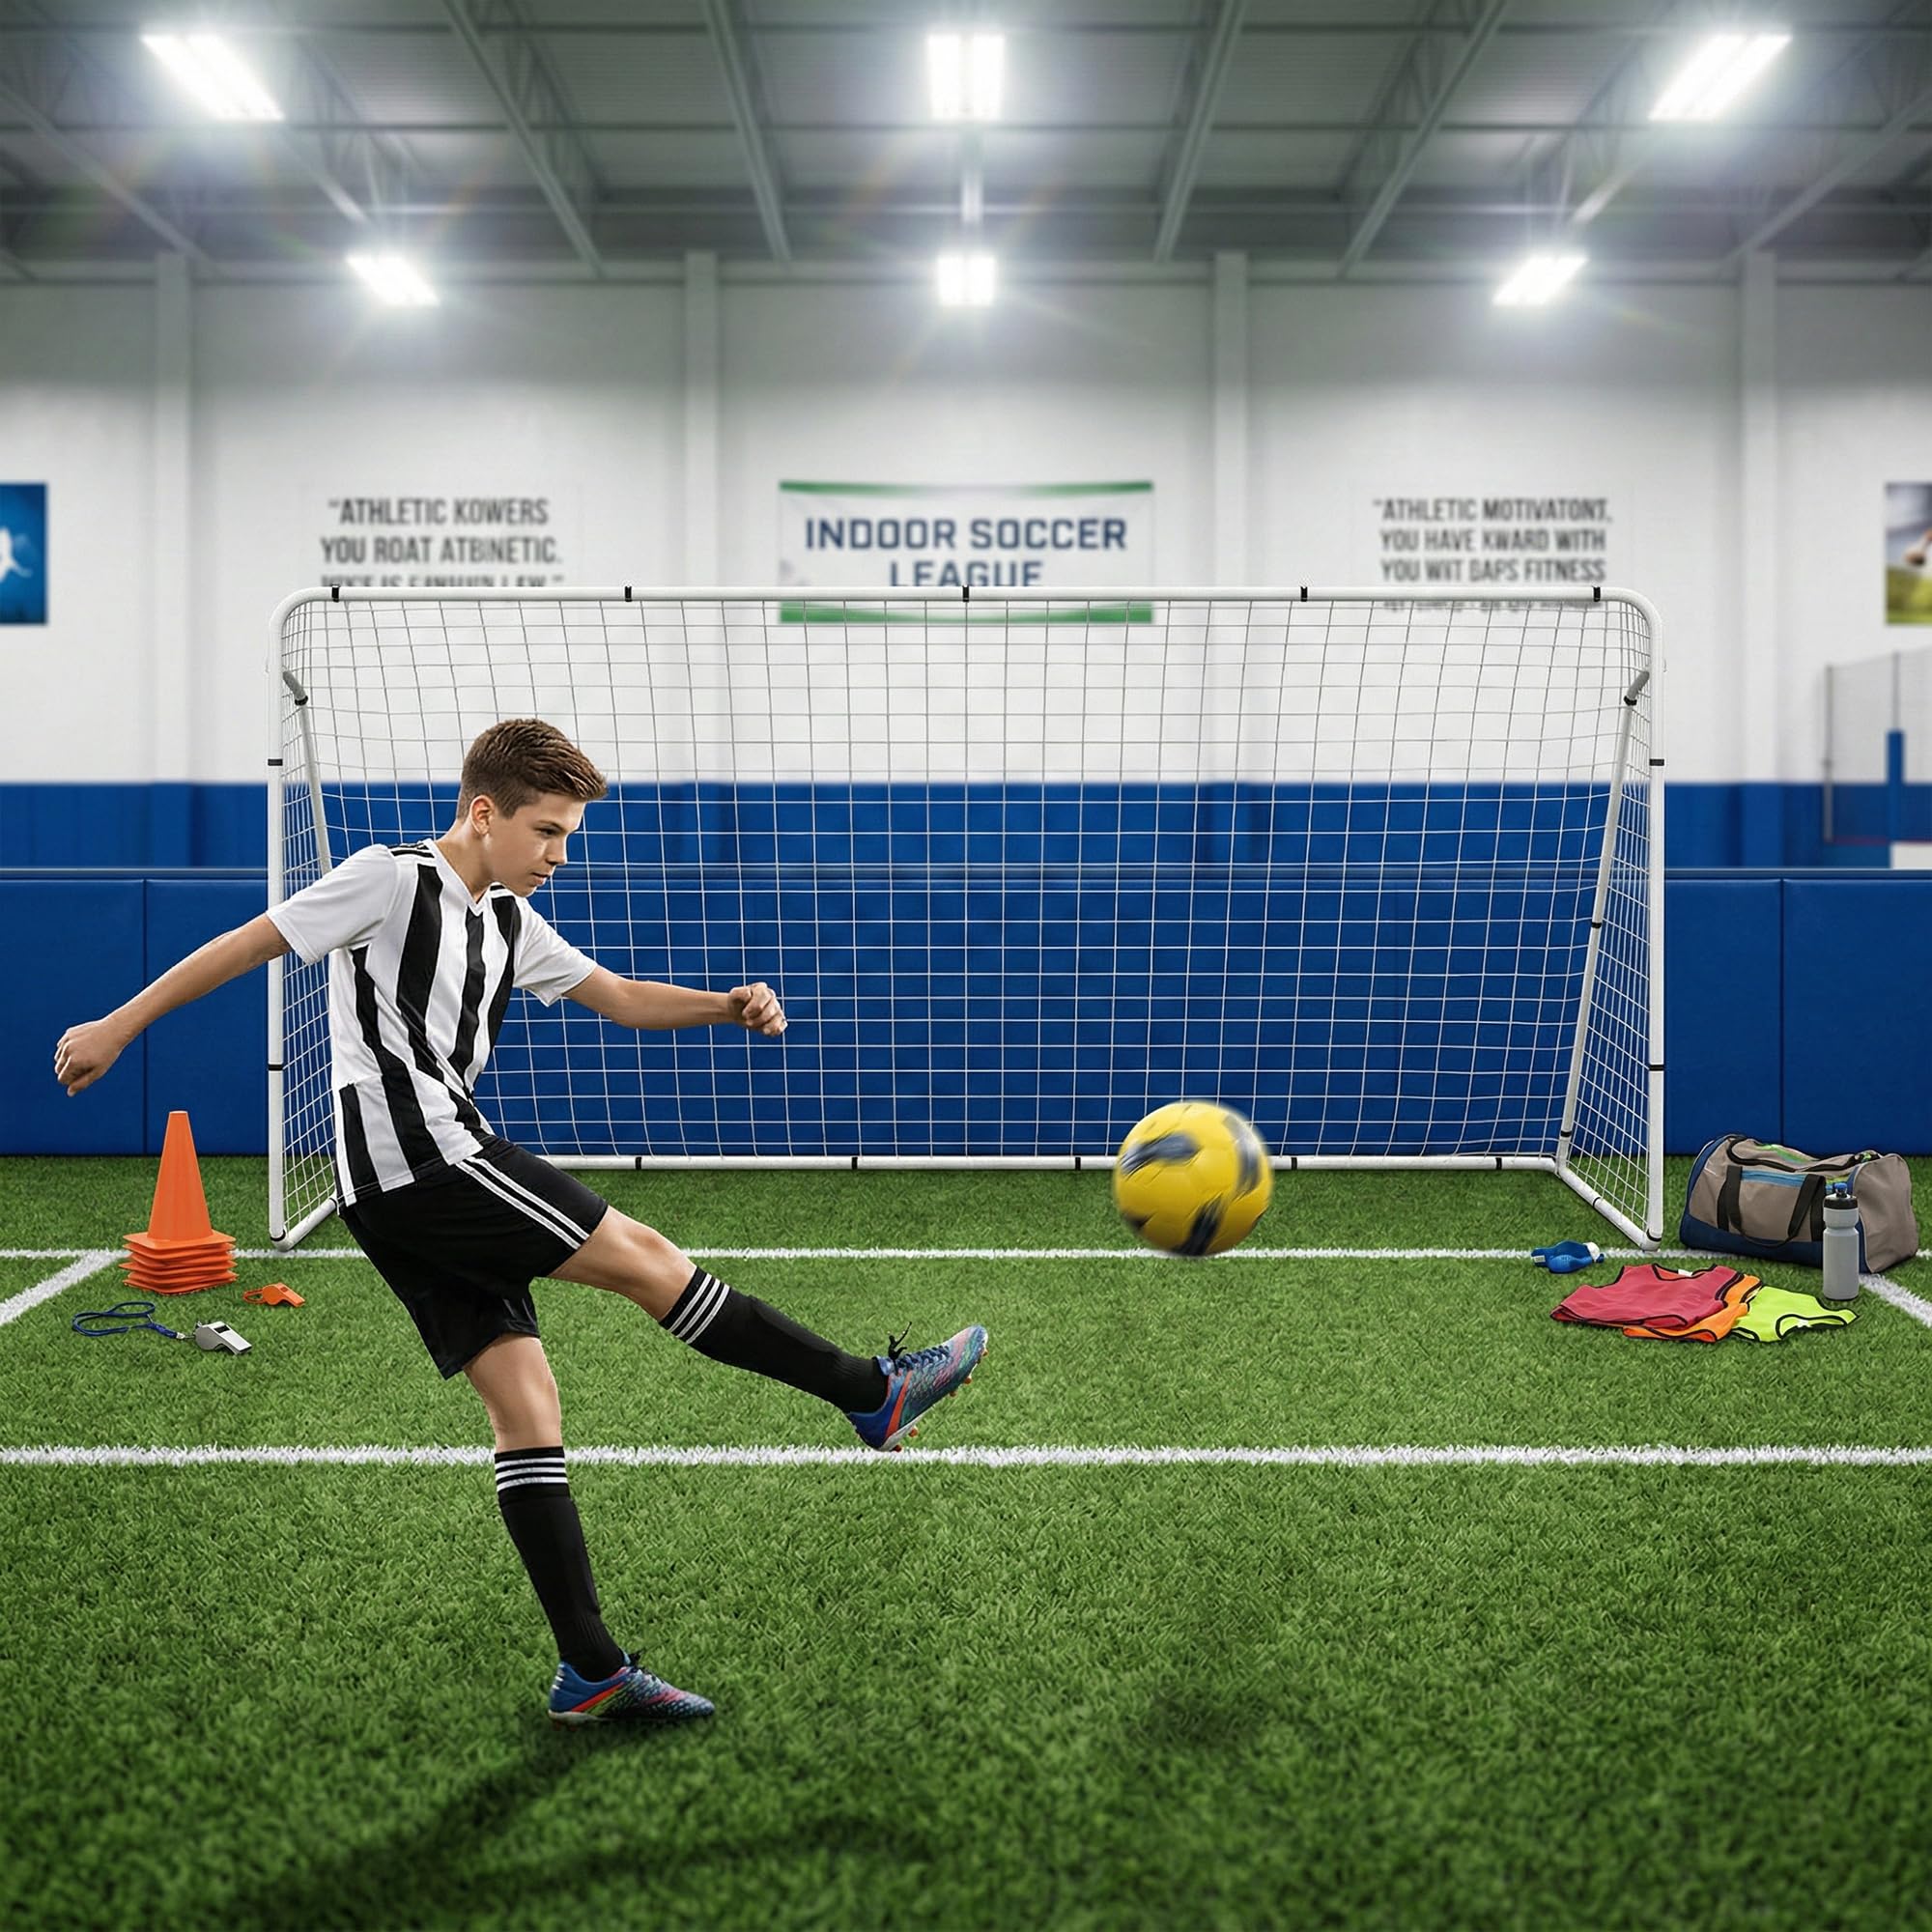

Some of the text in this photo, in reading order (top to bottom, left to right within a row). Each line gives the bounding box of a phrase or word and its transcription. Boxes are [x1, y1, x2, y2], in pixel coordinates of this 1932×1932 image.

[806, 518, 1127, 550] INDOOR SOCCER
[1379, 529, 1419, 552] YOU
[1424, 529, 1476, 552] HAVE
[1553, 529, 1606, 552] WITH
[320, 537, 366, 563] YOU
[890, 560, 1044, 586] LEAGUE
[1380, 559, 1420, 582] YOU
[1523, 559, 1606, 582] FITNESS
